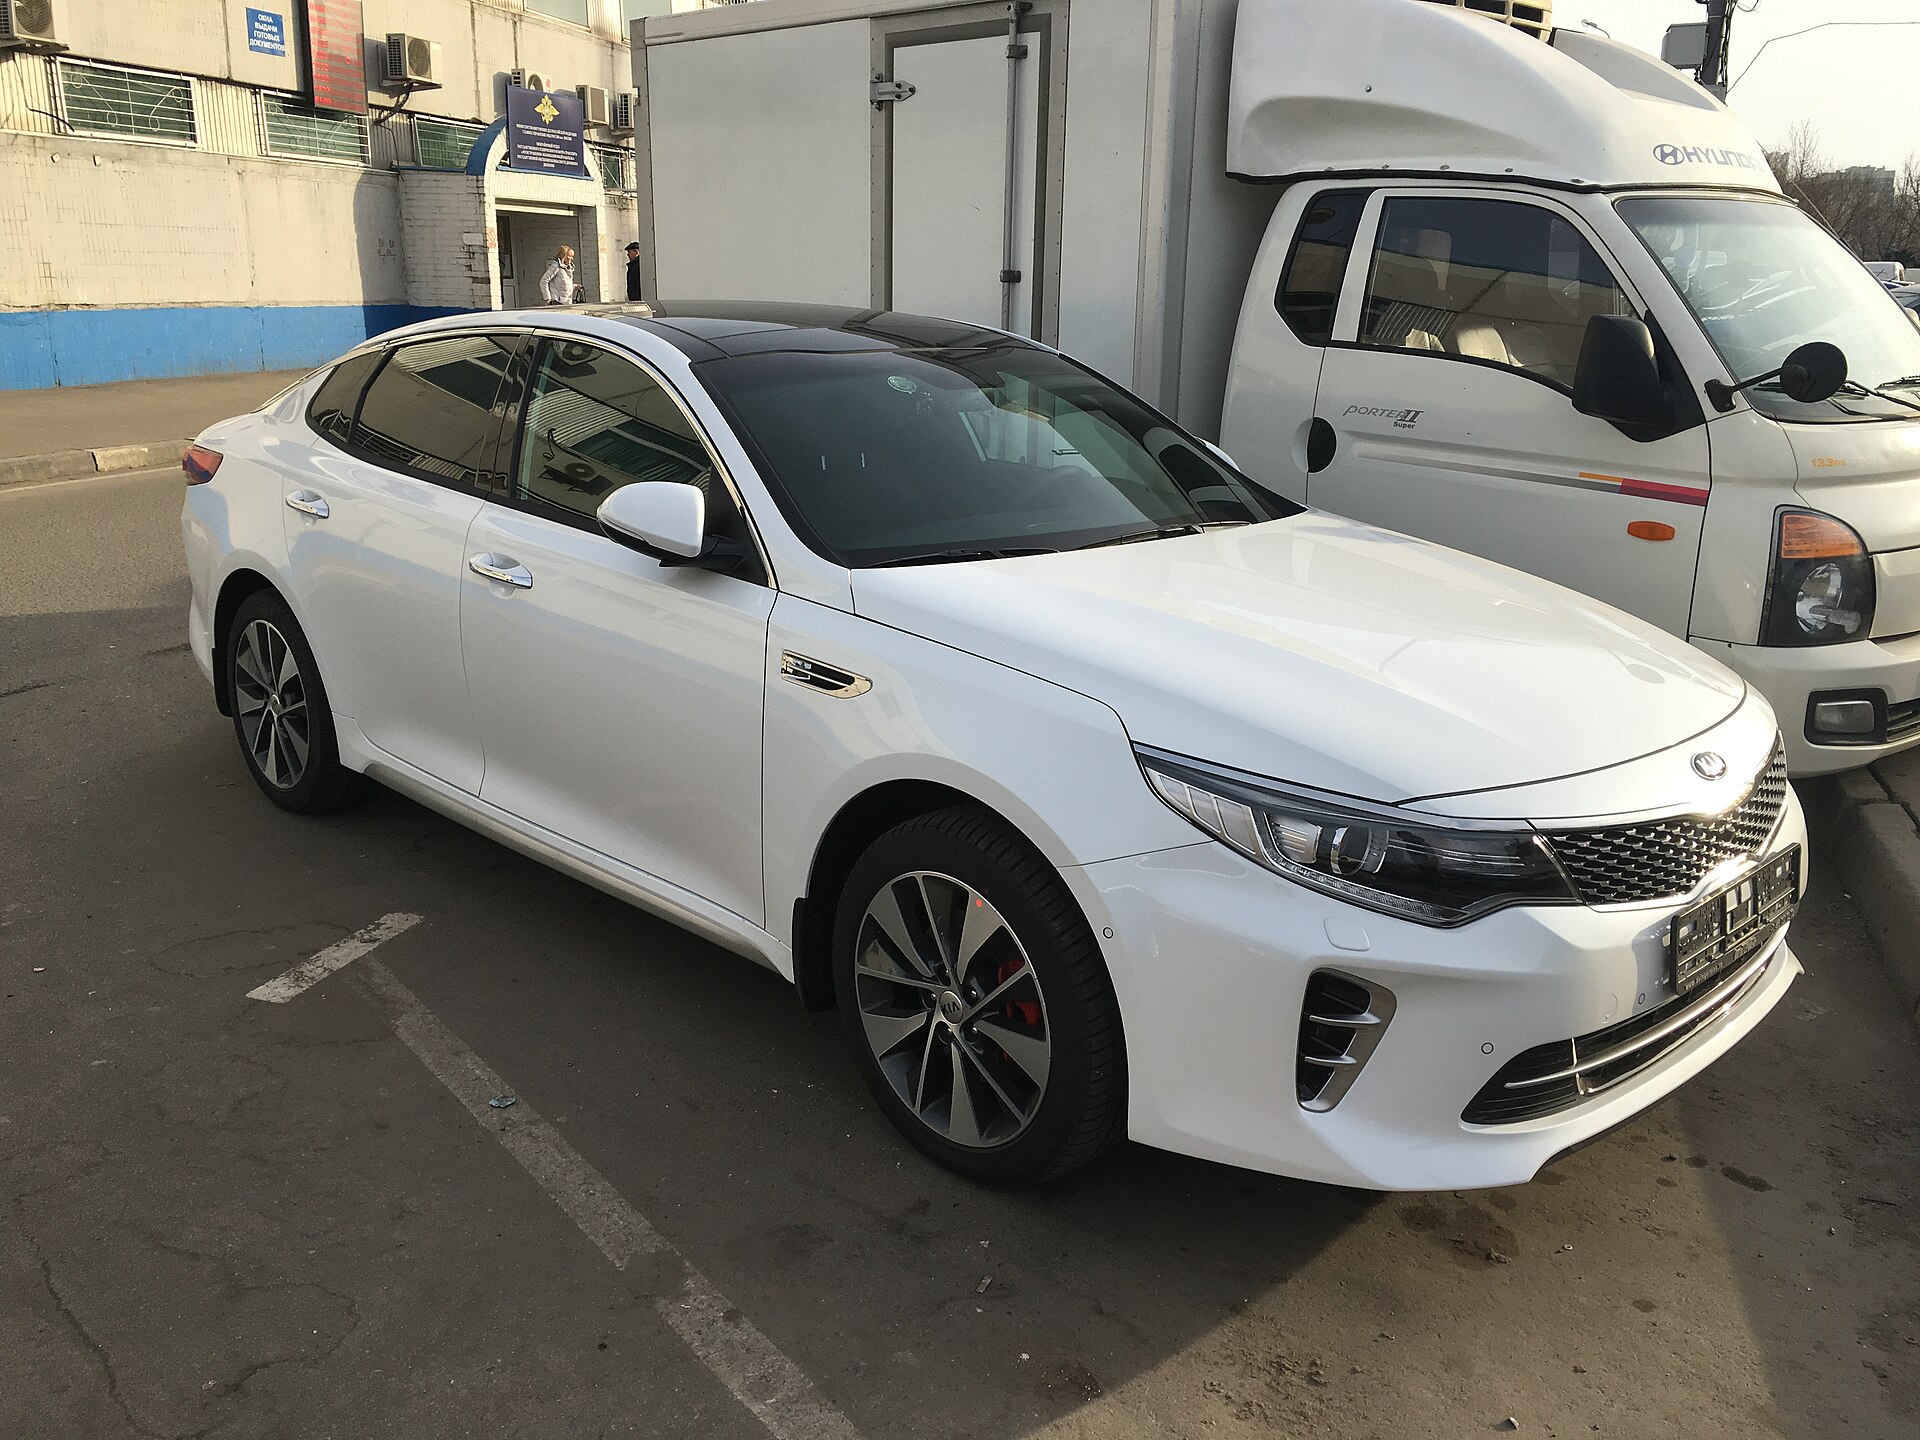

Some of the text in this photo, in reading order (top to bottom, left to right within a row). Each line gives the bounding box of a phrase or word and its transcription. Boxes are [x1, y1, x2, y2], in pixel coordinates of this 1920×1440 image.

[257, 13, 274, 23] ОКНА
[254, 21, 278, 33] ВЫДАЧИ
[253, 30, 280, 42] ГОТОВЫХ
[249, 37, 286, 51] ДОКУМЕНТОВ
[1681, 145, 1765, 173] HYUNDA
[1342, 405, 1407, 419] PORTER
[1393, 421, 1415, 430] Super
[940, 1001, 961, 1015] KIA
